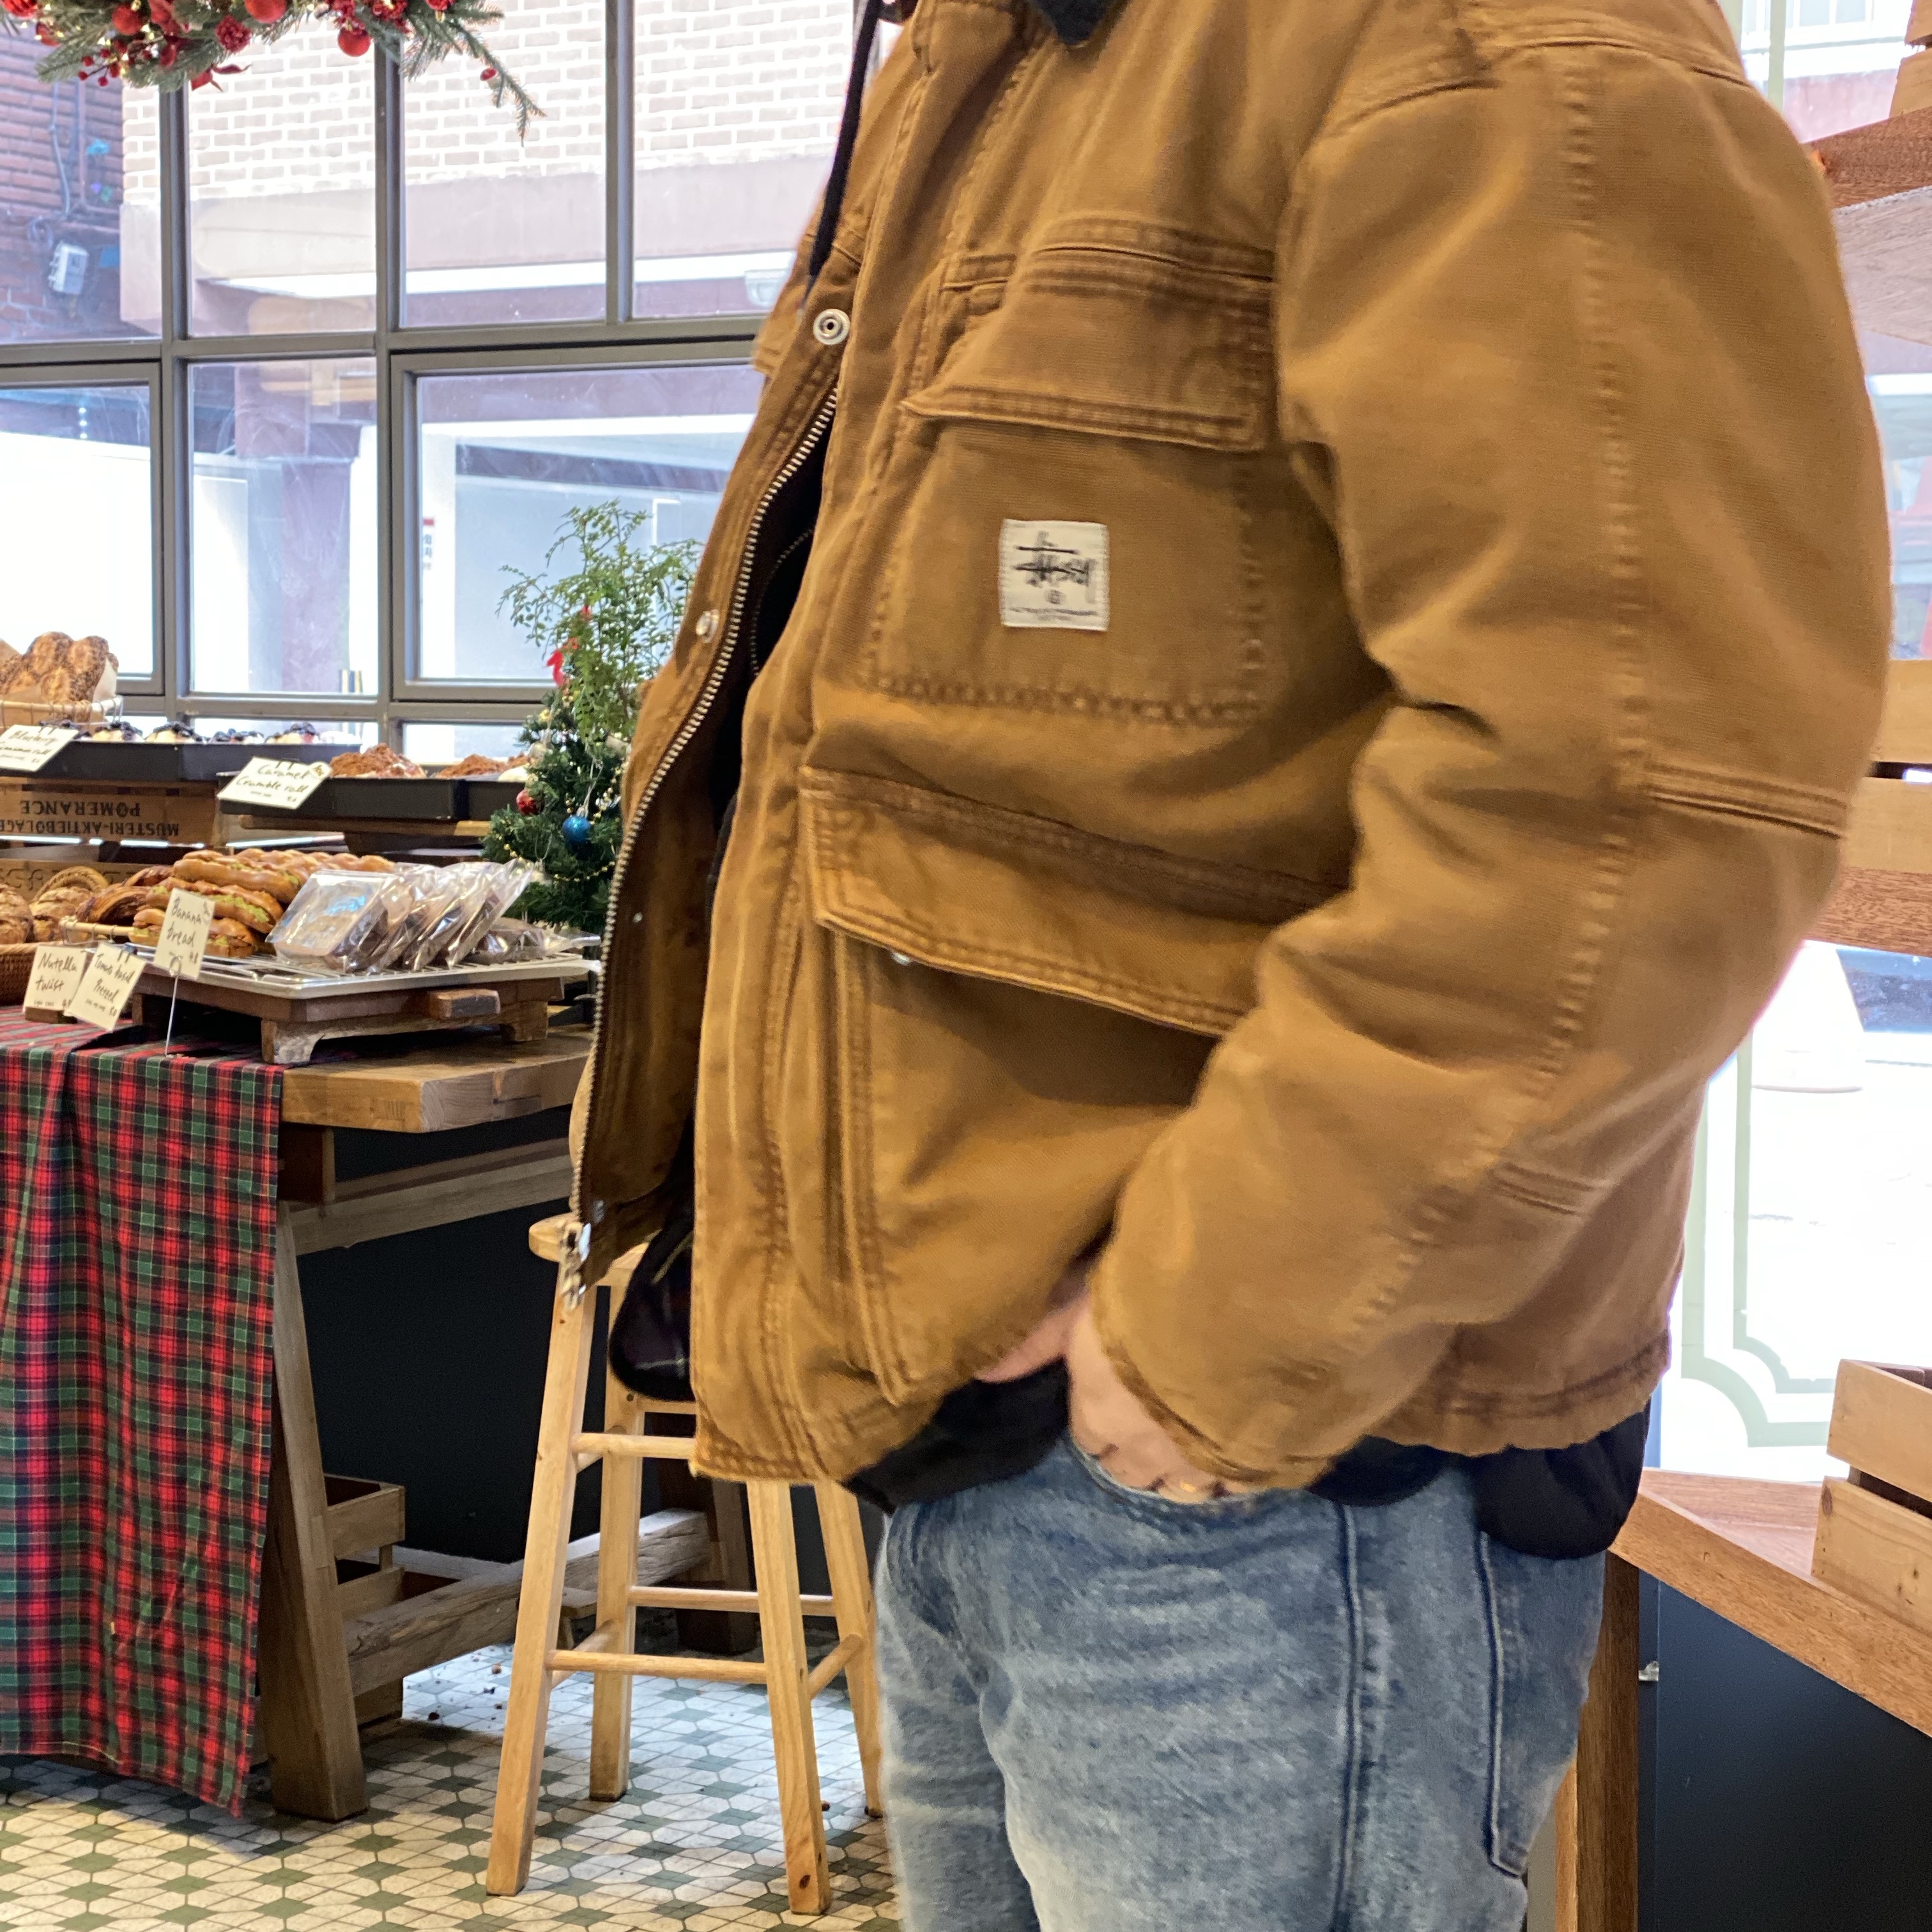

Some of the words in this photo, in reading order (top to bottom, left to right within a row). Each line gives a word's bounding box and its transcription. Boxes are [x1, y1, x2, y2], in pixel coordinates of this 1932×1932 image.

[258, 764, 310, 779] Caramel
[20, 800, 141, 818] POMERANCE
[171, 896, 202, 924] Banana
[167, 921, 196, 947] bread
[38, 953, 77, 972] Nutella
[36, 976, 64, 992] twist
[93, 977, 119, 1003] Pretzel
